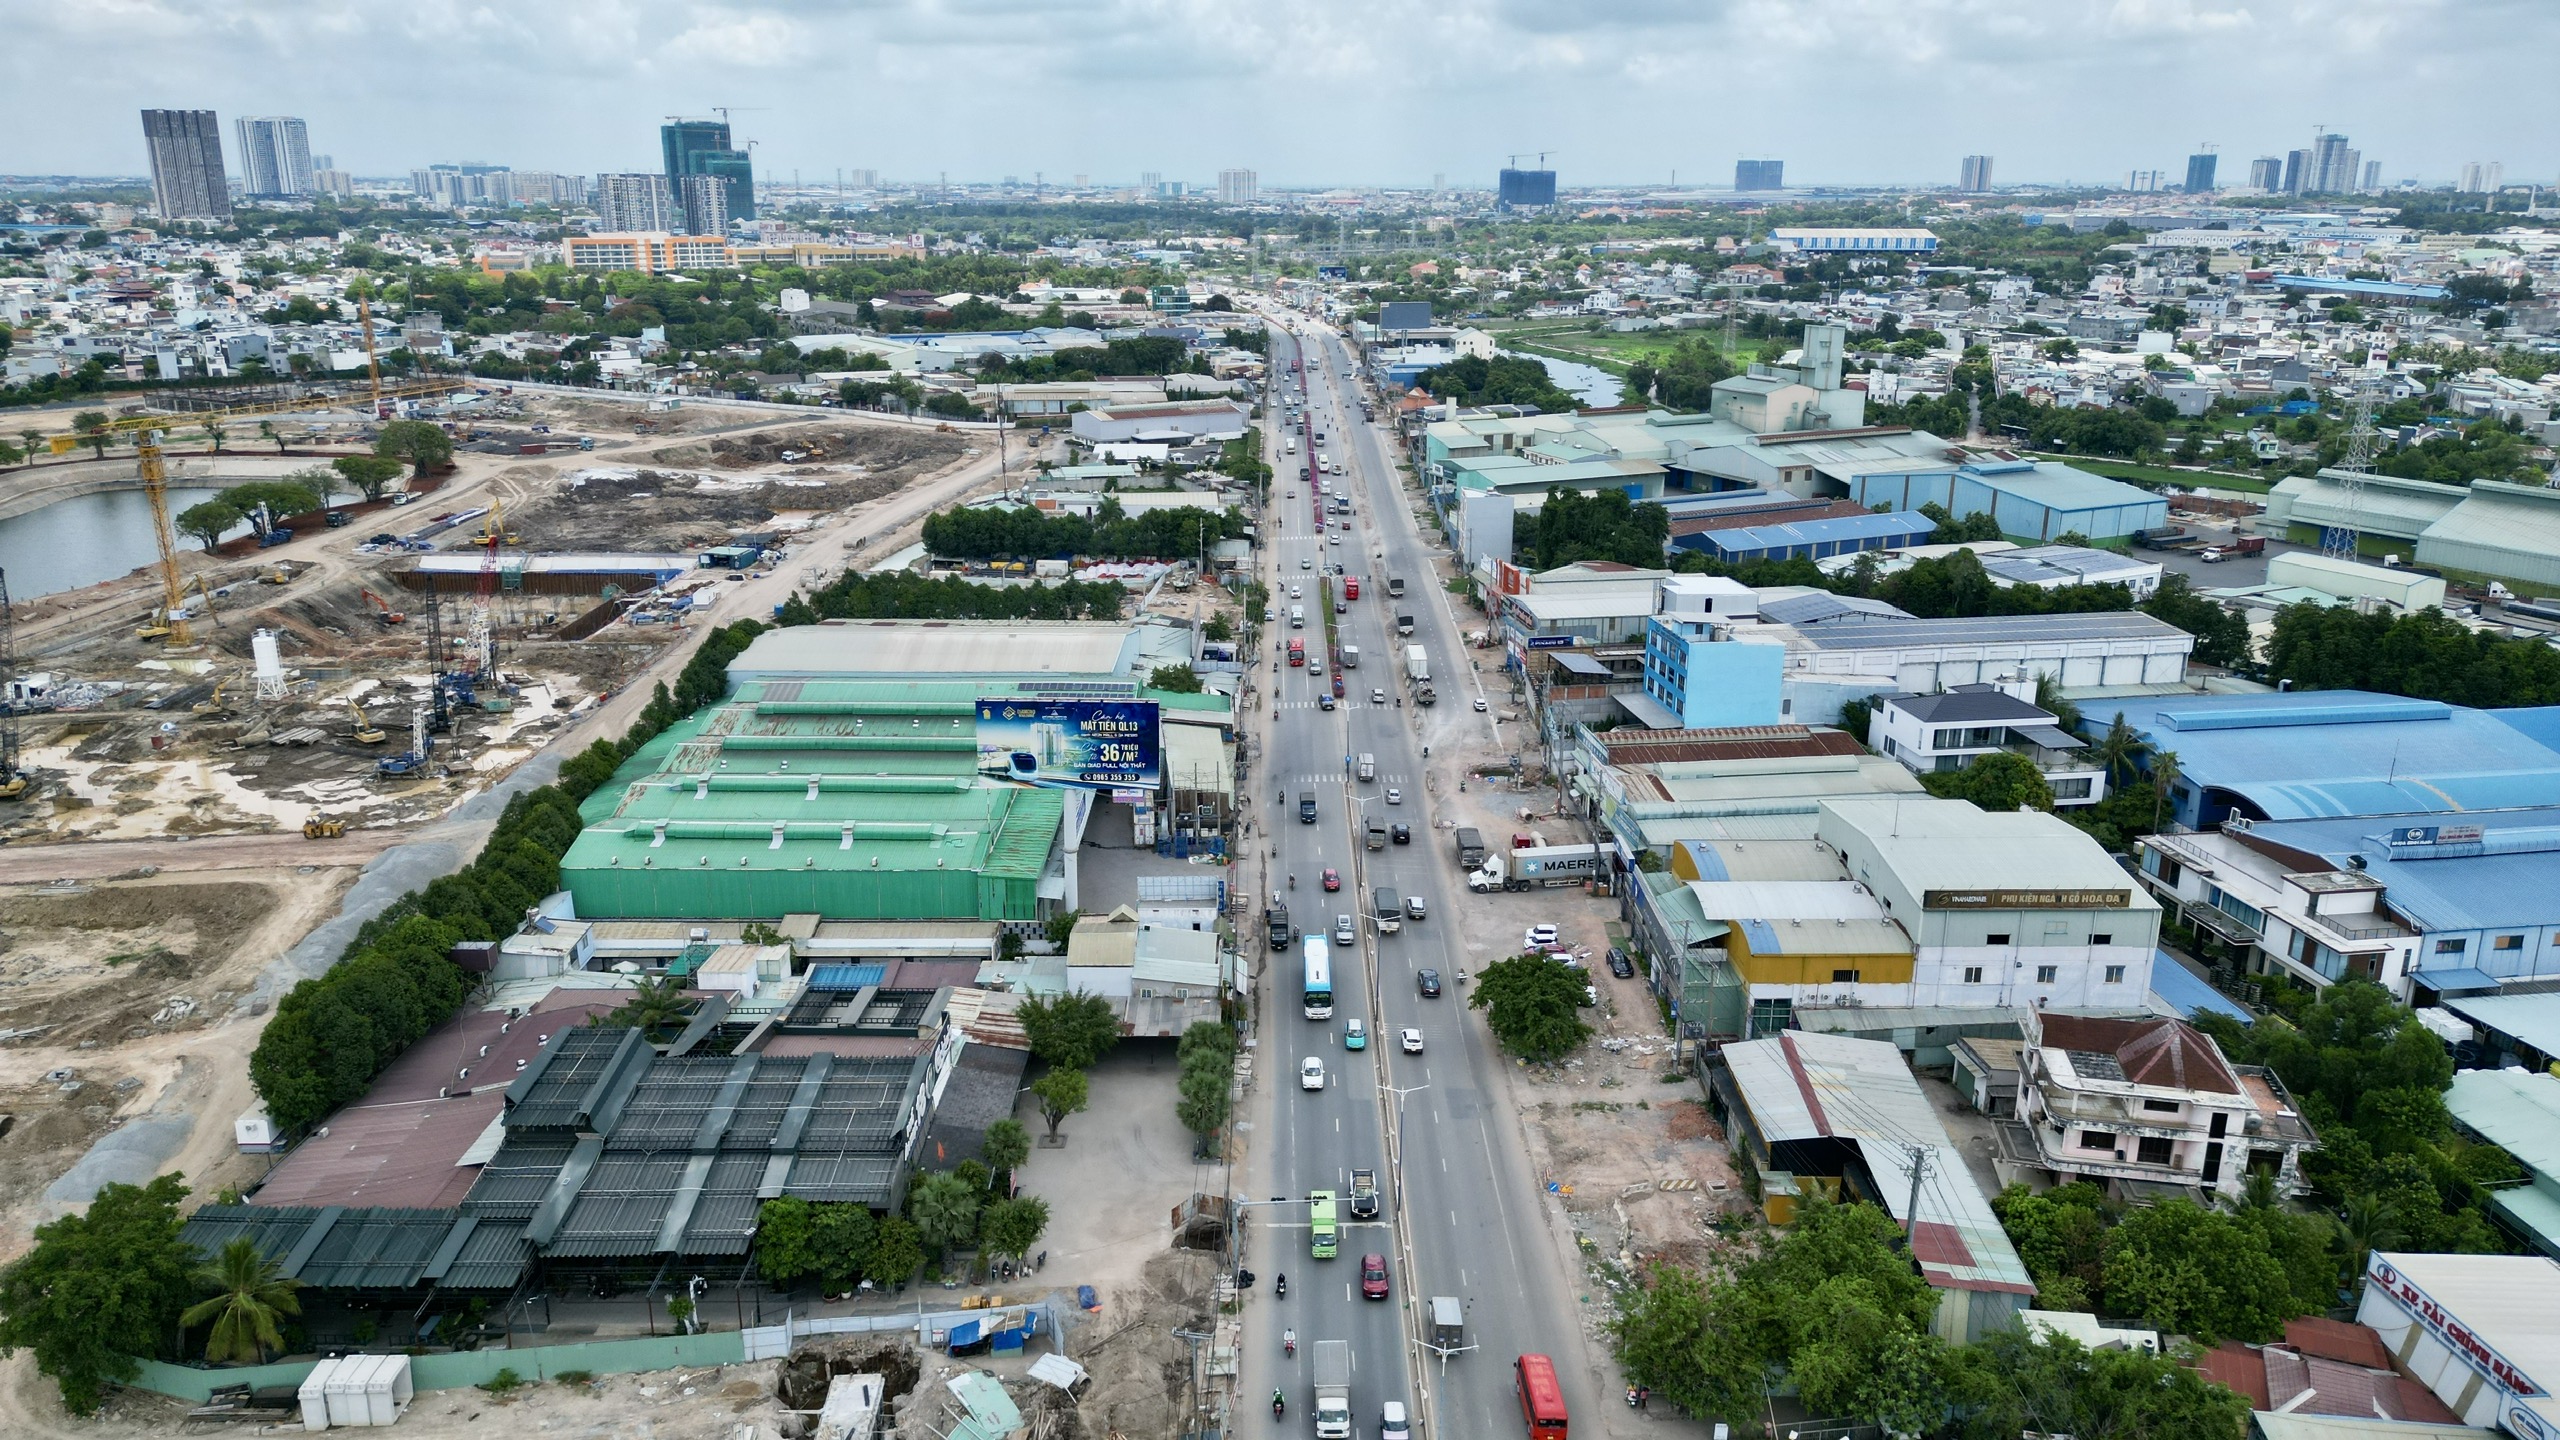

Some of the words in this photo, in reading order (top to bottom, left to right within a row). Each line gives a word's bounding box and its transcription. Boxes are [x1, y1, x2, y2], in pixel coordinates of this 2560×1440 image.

[1119, 721, 1138, 731] QL13
[1100, 743, 1119, 762] 36
[1544, 857, 1608, 871] MAERSK
[2001, 894, 2018, 905] PHỤ
[2018, 892, 2038, 905] KIỆN
[2039, 893, 2067, 903] NGÀH
[2081, 894, 2103, 903] HOA
[2401, 1284, 2419, 1307] XE
[2447, 1323, 2491, 1366] CHÍNH
